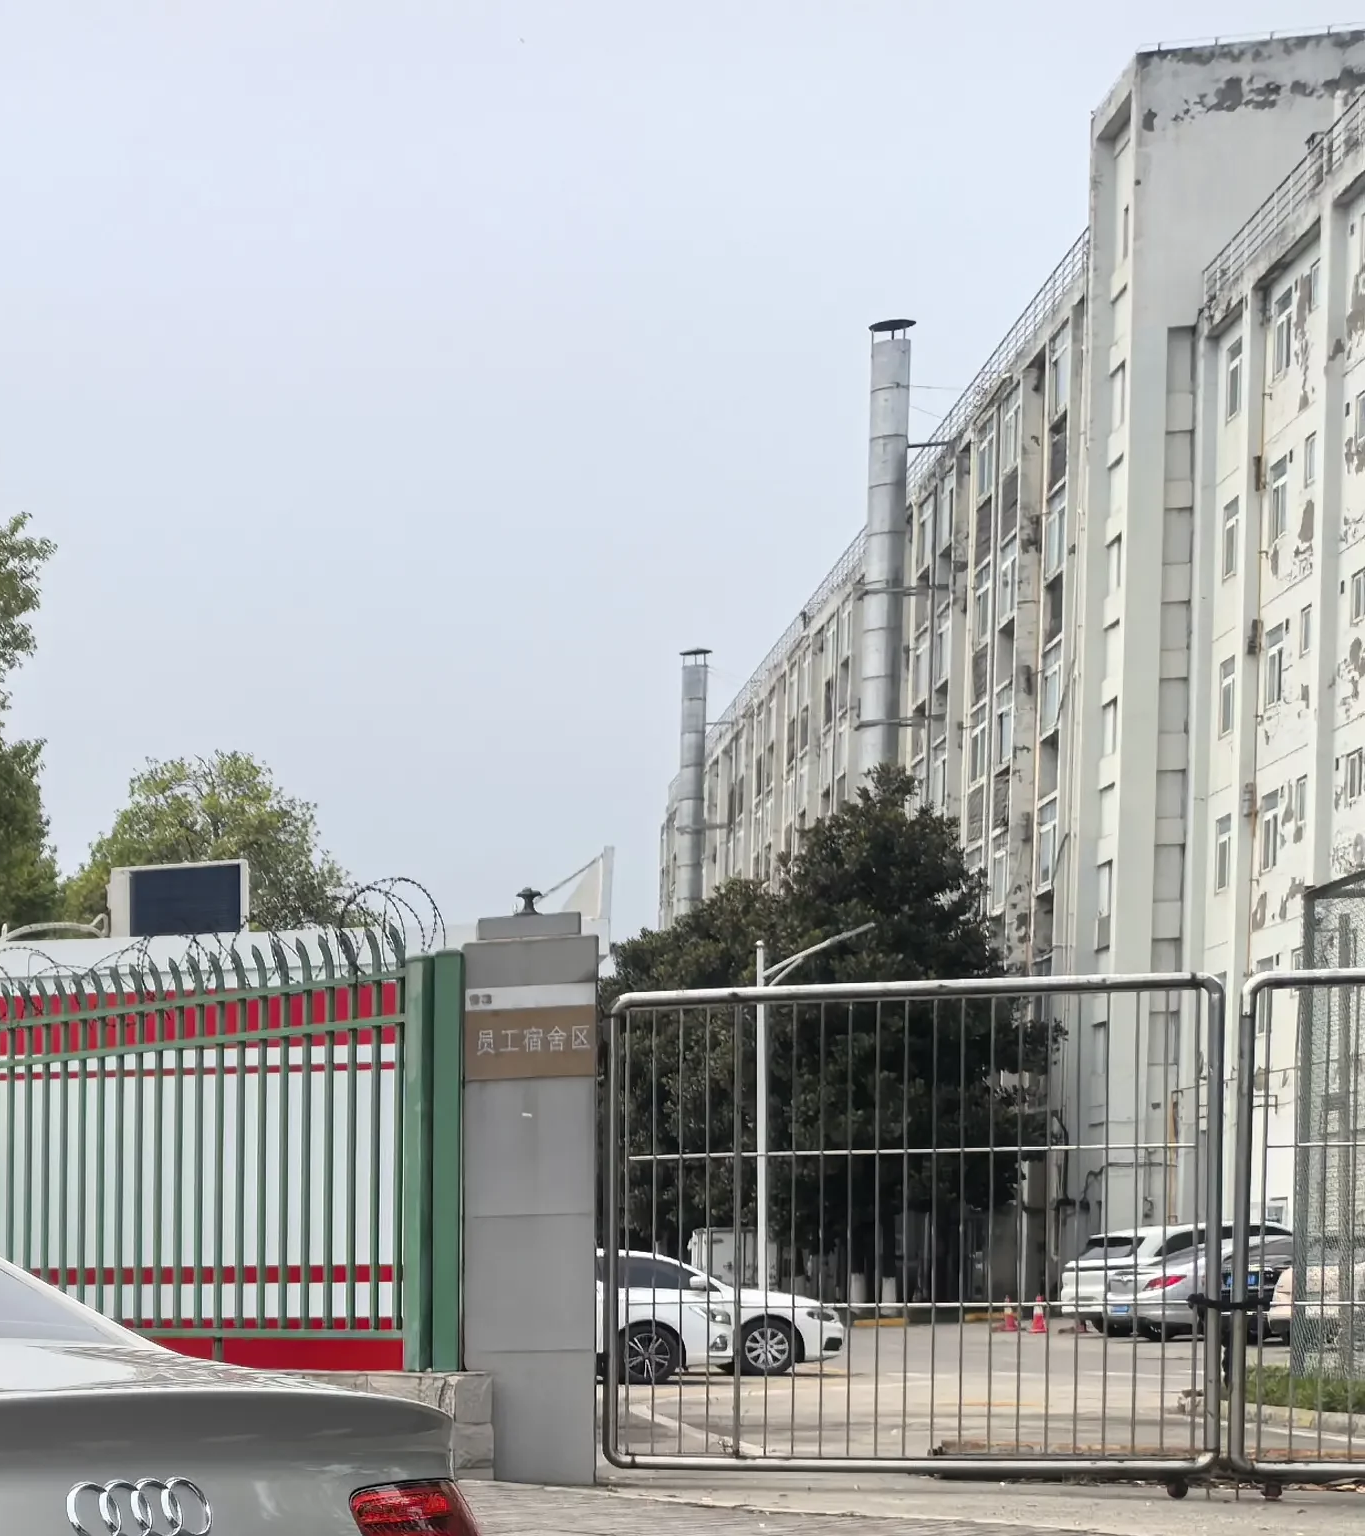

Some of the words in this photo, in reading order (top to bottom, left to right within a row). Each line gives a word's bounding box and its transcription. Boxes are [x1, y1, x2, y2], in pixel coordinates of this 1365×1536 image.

[476, 1025, 591, 1056] 员工宿舍区
